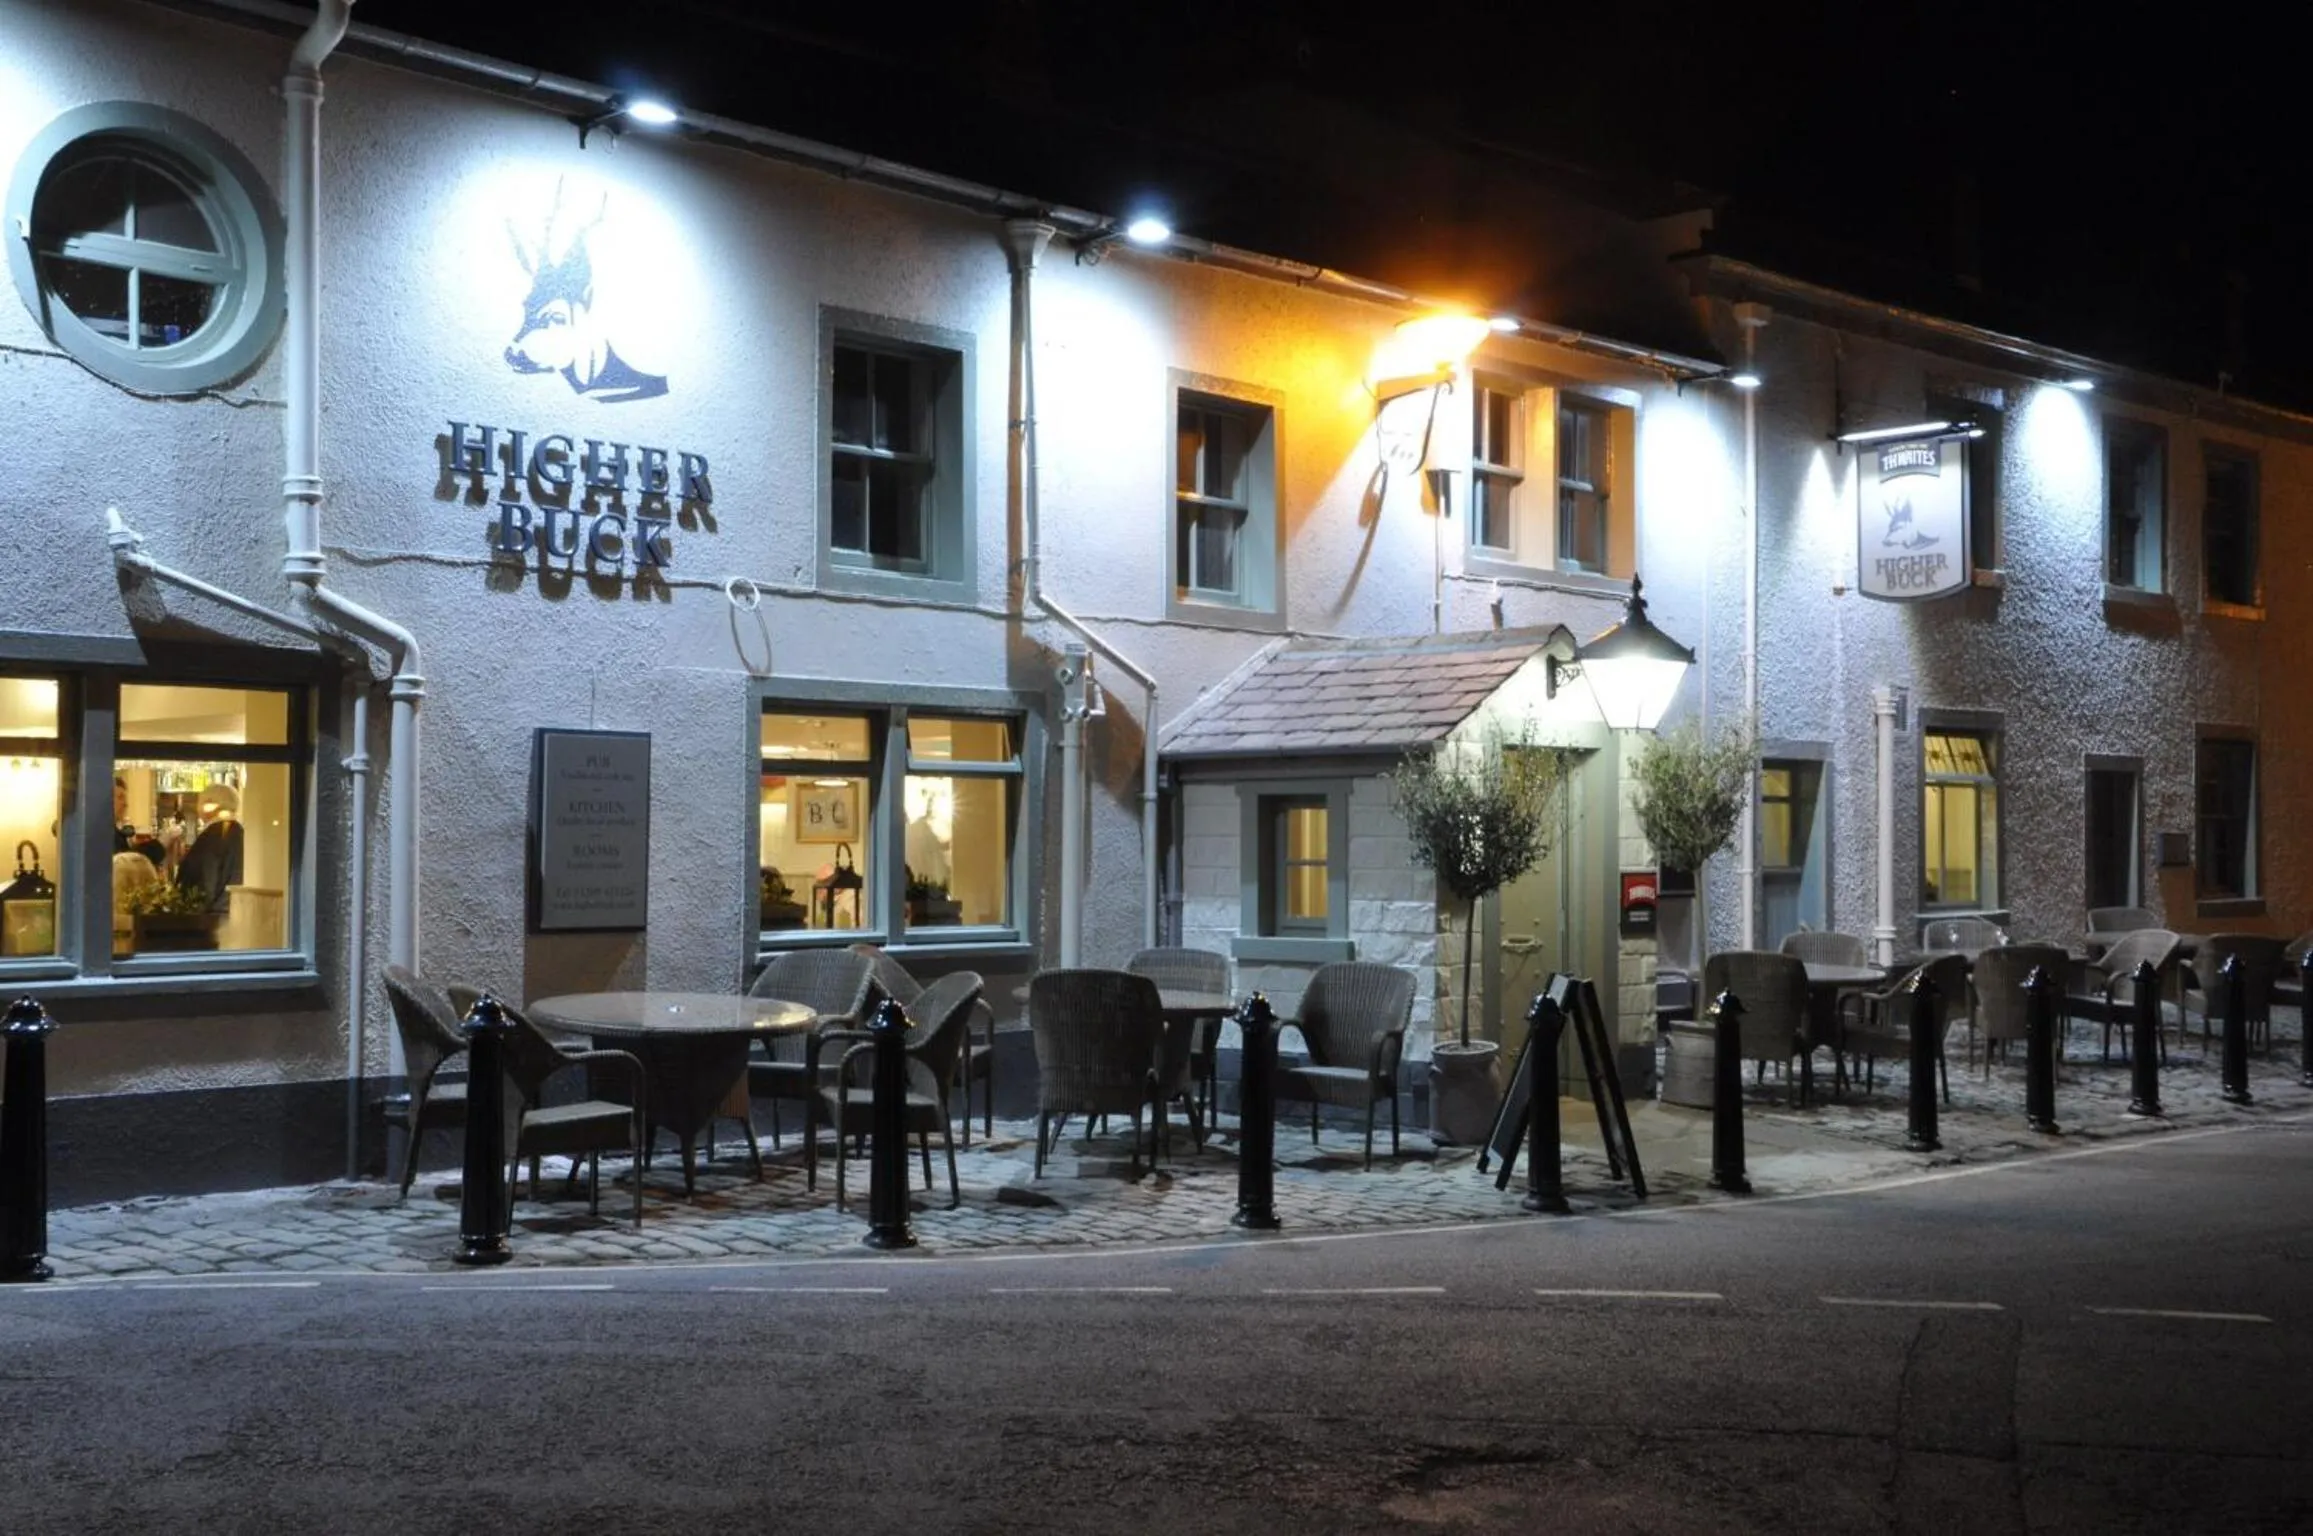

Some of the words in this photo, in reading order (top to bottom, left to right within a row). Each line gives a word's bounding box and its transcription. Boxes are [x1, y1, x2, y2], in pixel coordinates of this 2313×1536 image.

[448, 421, 712, 503] HIGHER
[497, 502, 672, 567] BUCK
[1876, 554, 1948, 575] HIGHER
[1886, 568, 1937, 590] BUCK
[569, 801, 625, 813] KITCHEN
